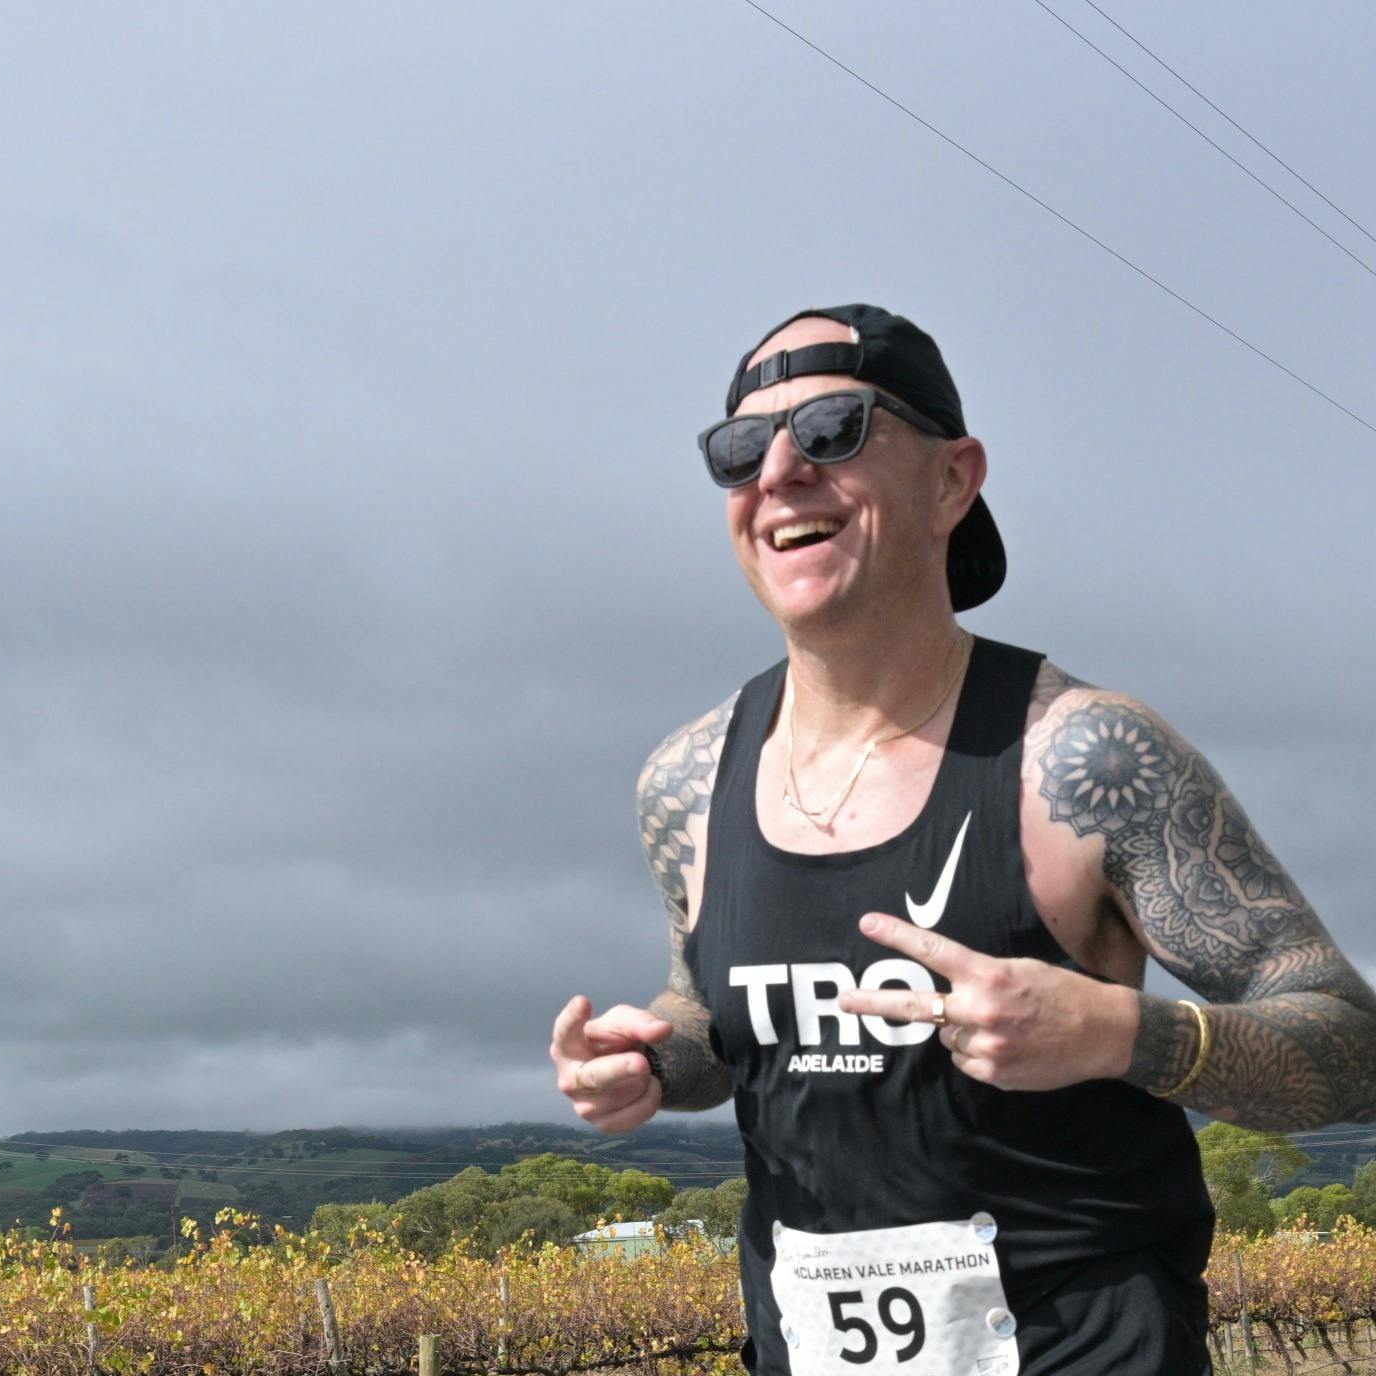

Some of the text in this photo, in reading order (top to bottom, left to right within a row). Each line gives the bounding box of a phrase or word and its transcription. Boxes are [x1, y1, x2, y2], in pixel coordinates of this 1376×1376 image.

[788, 1055, 883, 1073] ADELAIDE
[794, 1253, 990, 1281] MCLAREN VALE MARATHON
[827, 1286, 926, 1364] 59
